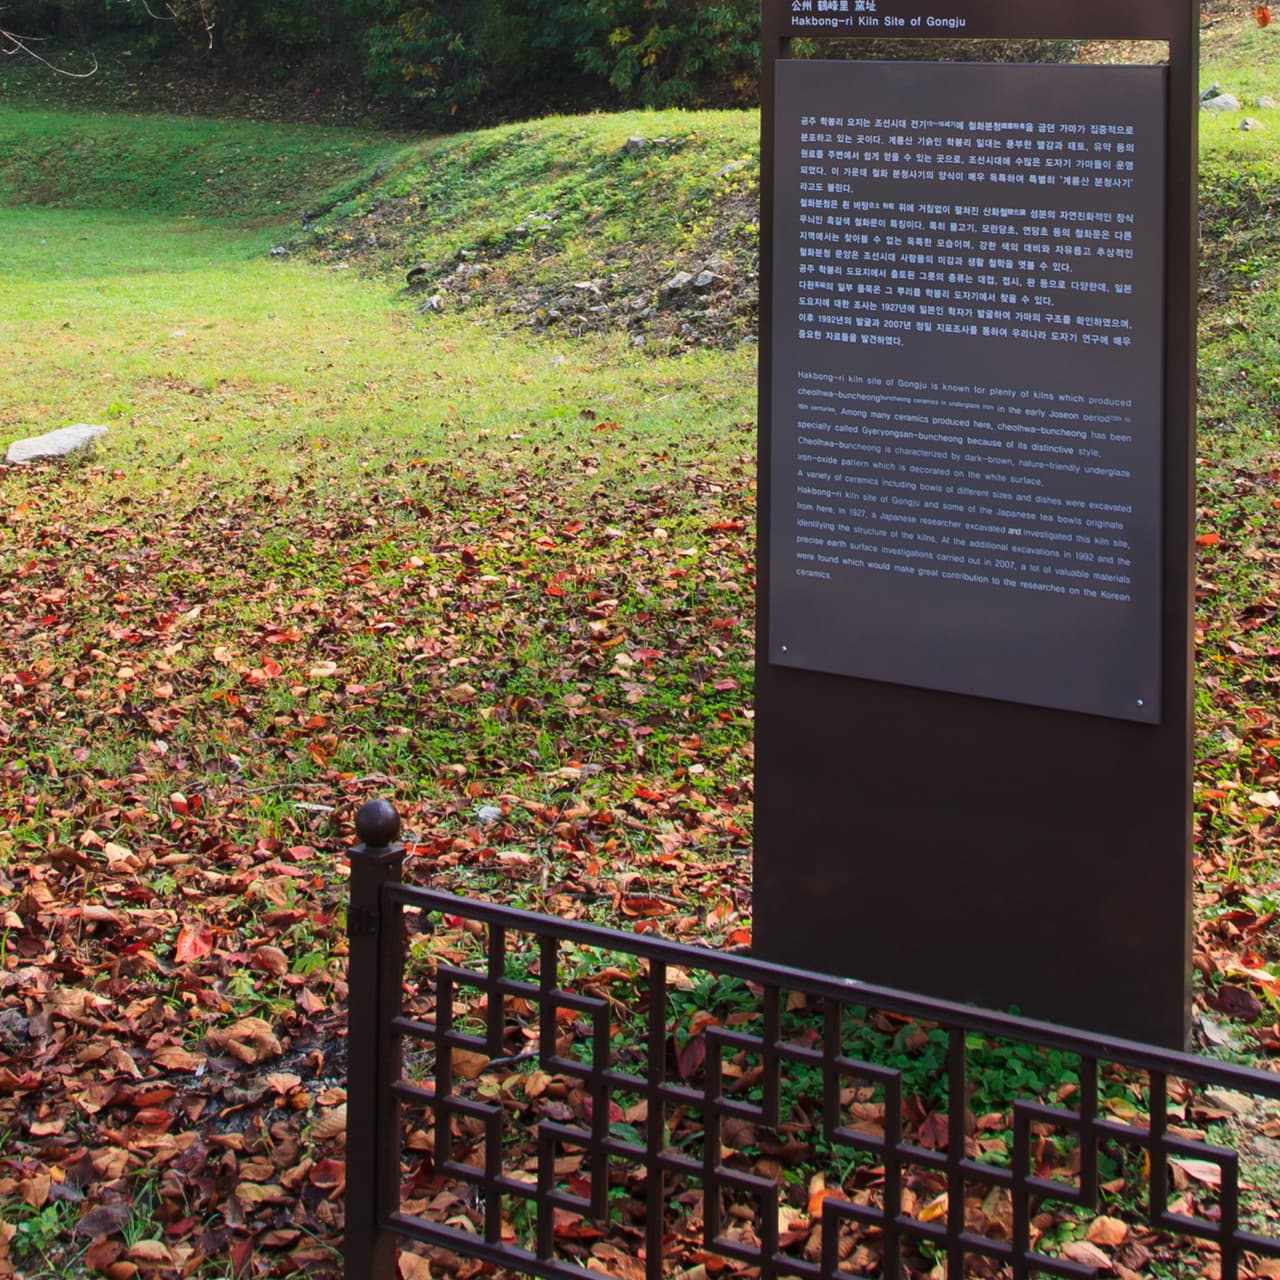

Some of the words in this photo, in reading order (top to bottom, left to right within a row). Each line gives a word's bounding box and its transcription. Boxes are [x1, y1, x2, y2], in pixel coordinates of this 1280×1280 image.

[792, 0, 812, 11] 公州
[791, 16, 853, 28] Hakbong-ri
[858, 16, 879, 26] Kiln
[884, 16, 905, 26] Site
[910, 16, 921, 26] of
[926, 16, 966, 29] Gongju
[800, 116, 817, 126] 공주
[820, 116, 844, 127] 학봉리
[847, 117, 871, 128] 요지는
[874, 118, 907, 129] 조선시대
[1059, 123, 1086, 135] 가마가
[800, 132, 833, 143] 분포하고
[836, 133, 853, 144] 있는
[888, 135, 913, 146] 계룡산
[946, 137, 972, 148] 학봉리
[1093, 142, 1112, 153] 유약
[1116, 142, 1135, 153] 등의
[800, 148, 824, 160] 원료를
[827, 150, 860, 161] 주변에서
[903, 152, 913, 162] 수
[915, 153, 933, 164] 있는
[1044, 158, 1072, 169] 도자기
[1075, 159, 1112, 170] 가마들이
[831, 167, 840, 177] 이
[843, 167, 868, 177] 가운데
[872, 167, 889, 178] 철화
[937, 170, 964, 182] 양식이
[967, 172, 985, 183] 매우
[799, 182, 824, 192] 라고도
[898, 202, 915, 213] 위에
[929, 220, 946, 232] 특히
[1114, 230, 1133, 241] 다른
[872, 235, 881, 245] 수
[885, 235, 903, 246] 없는
[979, 240, 997, 252] 강한
[863, 251, 896, 263] 조선시대
[1039, 261, 1049, 272] 수
[799, 263, 815, 274] 공주
[818, 264, 842, 276] 학봉리
[1114, 283, 1133, 295] 일본
[884, 286, 893, 295] 그
[925, 288, 950, 300] 학봉리
[1021, 294, 1030, 305] 수
[798, 296, 830, 308] 도요지에
[833, 299, 850, 309] 대한
[853, 300, 878, 311] 조사는
[919, 304, 944, 316] 일본인
[947, 306, 973, 318] 학자가
[1015, 311, 1041, 323] 가마의
[798, 312, 814, 323] 이후
[1011, 328, 1047, 340] 우리나라
[1050, 331, 1078, 343] 도자기
[1081, 334, 1109, 345] 연구에
[1112, 336, 1132, 347] 매우
[798, 328, 822, 341] 중요한
[825, 331, 857, 343] 자료들을
[797, 370, 845, 383] Hakbong-ri
[847, 375, 864, 384] kiln
[866, 377, 882, 386] site
[885, 378, 894, 387] of
[897, 378, 928, 391] Gongju
[942, 383, 970, 393] known
[973, 385, 986, 395] for
[989, 387, 1017, 399] plenty
[1019, 390, 1030, 399] of
[1032, 391, 1055, 401] kilns
[1058, 393, 1085, 403] which
[1088, 396, 1133, 408] produced
[996, 405, 1006, 413] in
[1007, 406, 1022, 415] the
[1024, 408, 1046, 419] early
[1048, 409, 1080, 420] Joseon
[840, 407, 868, 420] Among
[870, 411, 892, 421] many
[893, 413, 929, 424] ceramics
[931, 417, 970, 428] produced
[1109, 432, 1132, 443] been
[797, 420, 832, 432] specially
[834, 424, 859, 434] called
[966, 436, 1003, 448] because
[1030, 442, 1074, 455] distinctive
[797, 453, 838, 465] iron-oxide
[840, 458, 870, 468] pattern
[908, 465, 951, 477] decorated
[984, 473, 1007, 483] white
[1083, 466, 1131, 478] underglaze
[806, 471, 832, 481] variety
[844, 475, 879, 486] ceramics
[956, 486, 990, 497] different
[1088, 502, 1132, 514] excavated
[796, 485, 842, 499] Hakbong-ri
[862, 493, 878, 503] site
[891, 495, 921, 508] Gongju
[995, 508, 1037, 521] Japanese
[1056, 514, 1083, 526] bowls
[1085, 519, 1124, 530] originate
[879, 511, 917, 524] Japanese
[919, 517, 962, 529] researcher
[964, 522, 1006, 535] excavated
[1007, 527, 1022, 536] and
[796, 519, 836, 532] identifying
[1011, 545, 1061, 558] excavations
[1075, 551, 1095, 562] 1992
[796, 535, 825, 546] precise
[826, 539, 847, 548] earth
[1054, 567, 1090, 579] valuable
[1092, 572, 1131, 585] materials
[817, 553, 840, 564] found
[841, 558, 865, 567] which
[867, 562, 891, 571] would
[941, 571, 990, 584] contribution
[1019, 581, 1066, 594] researches
[1100, 590, 1131, 602] Korean
